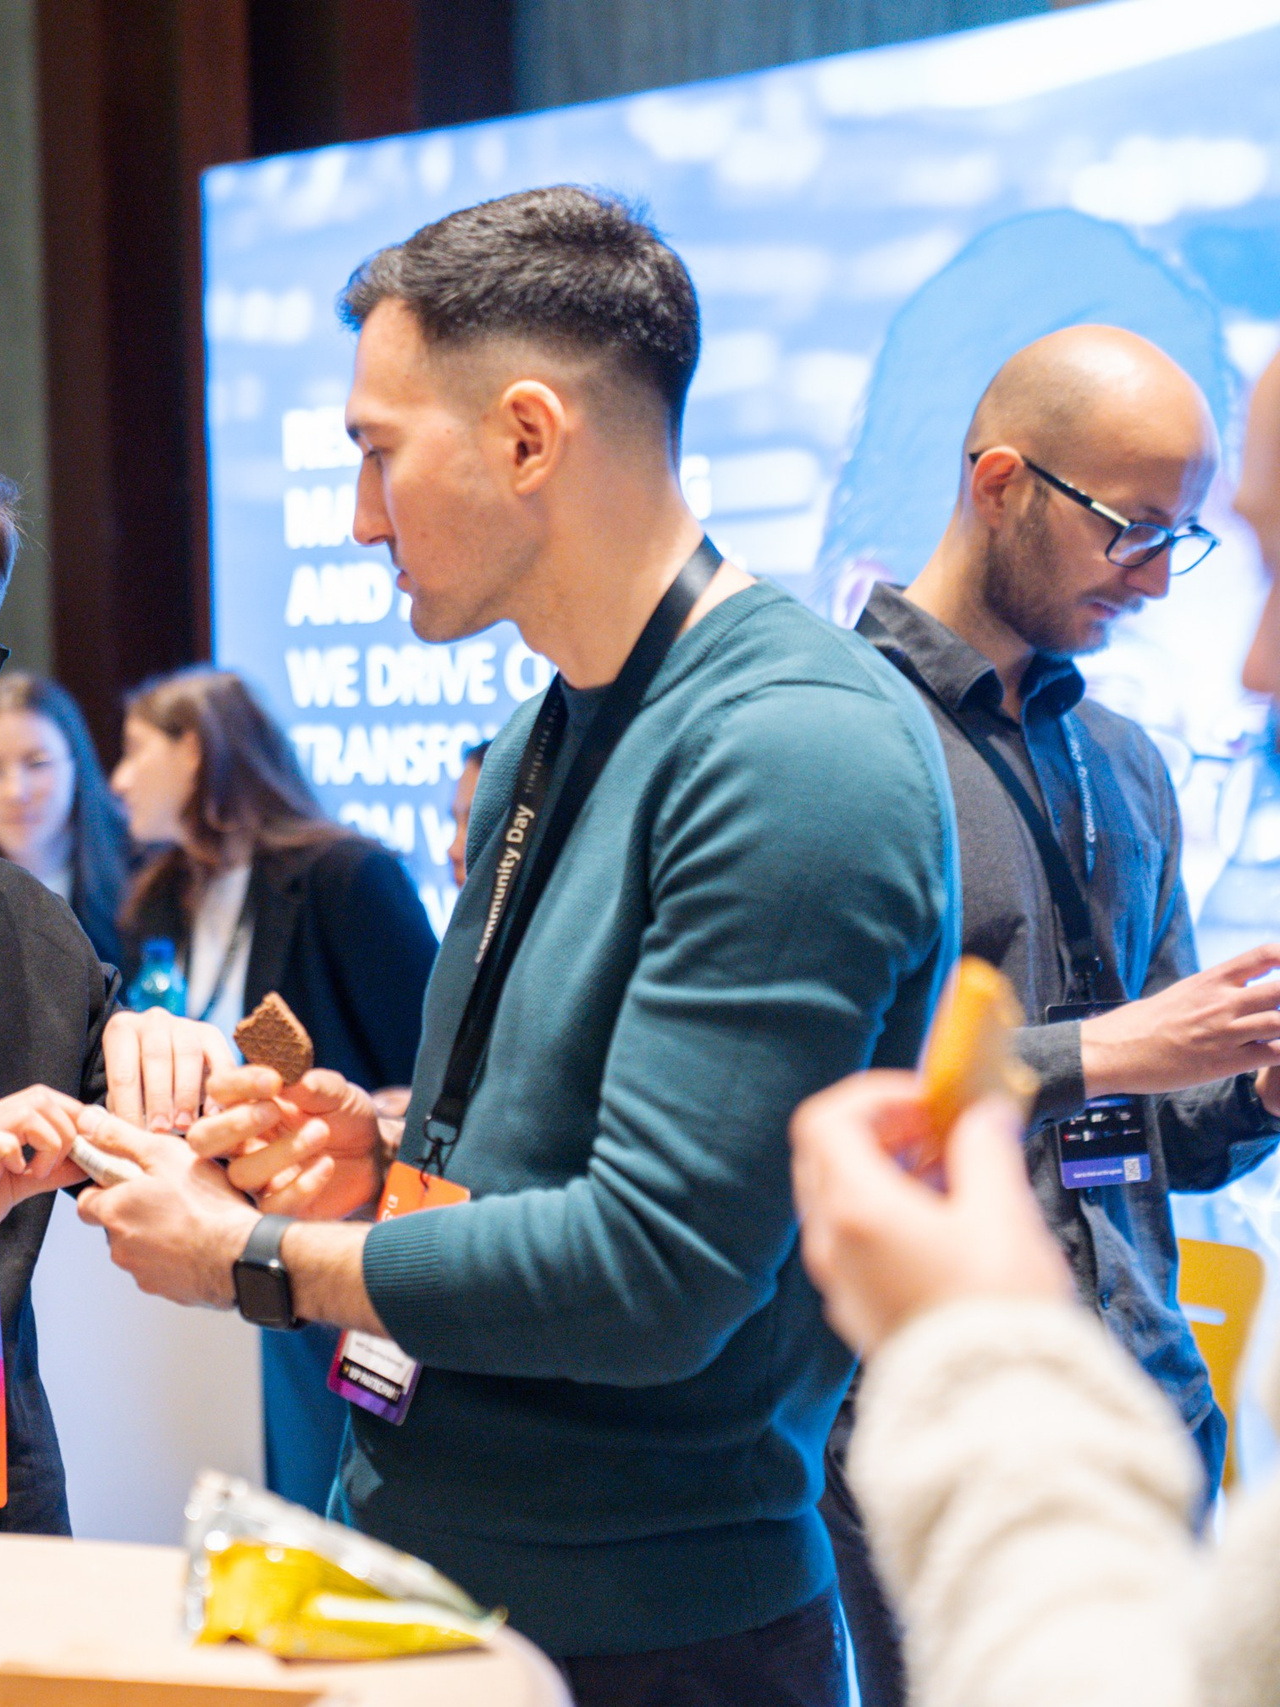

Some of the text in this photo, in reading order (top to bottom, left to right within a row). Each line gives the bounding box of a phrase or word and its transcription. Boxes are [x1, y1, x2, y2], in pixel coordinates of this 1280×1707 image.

[286, 563, 392, 626] AND
[287, 648, 358, 706] WE
[506, 804, 535, 843] Day
